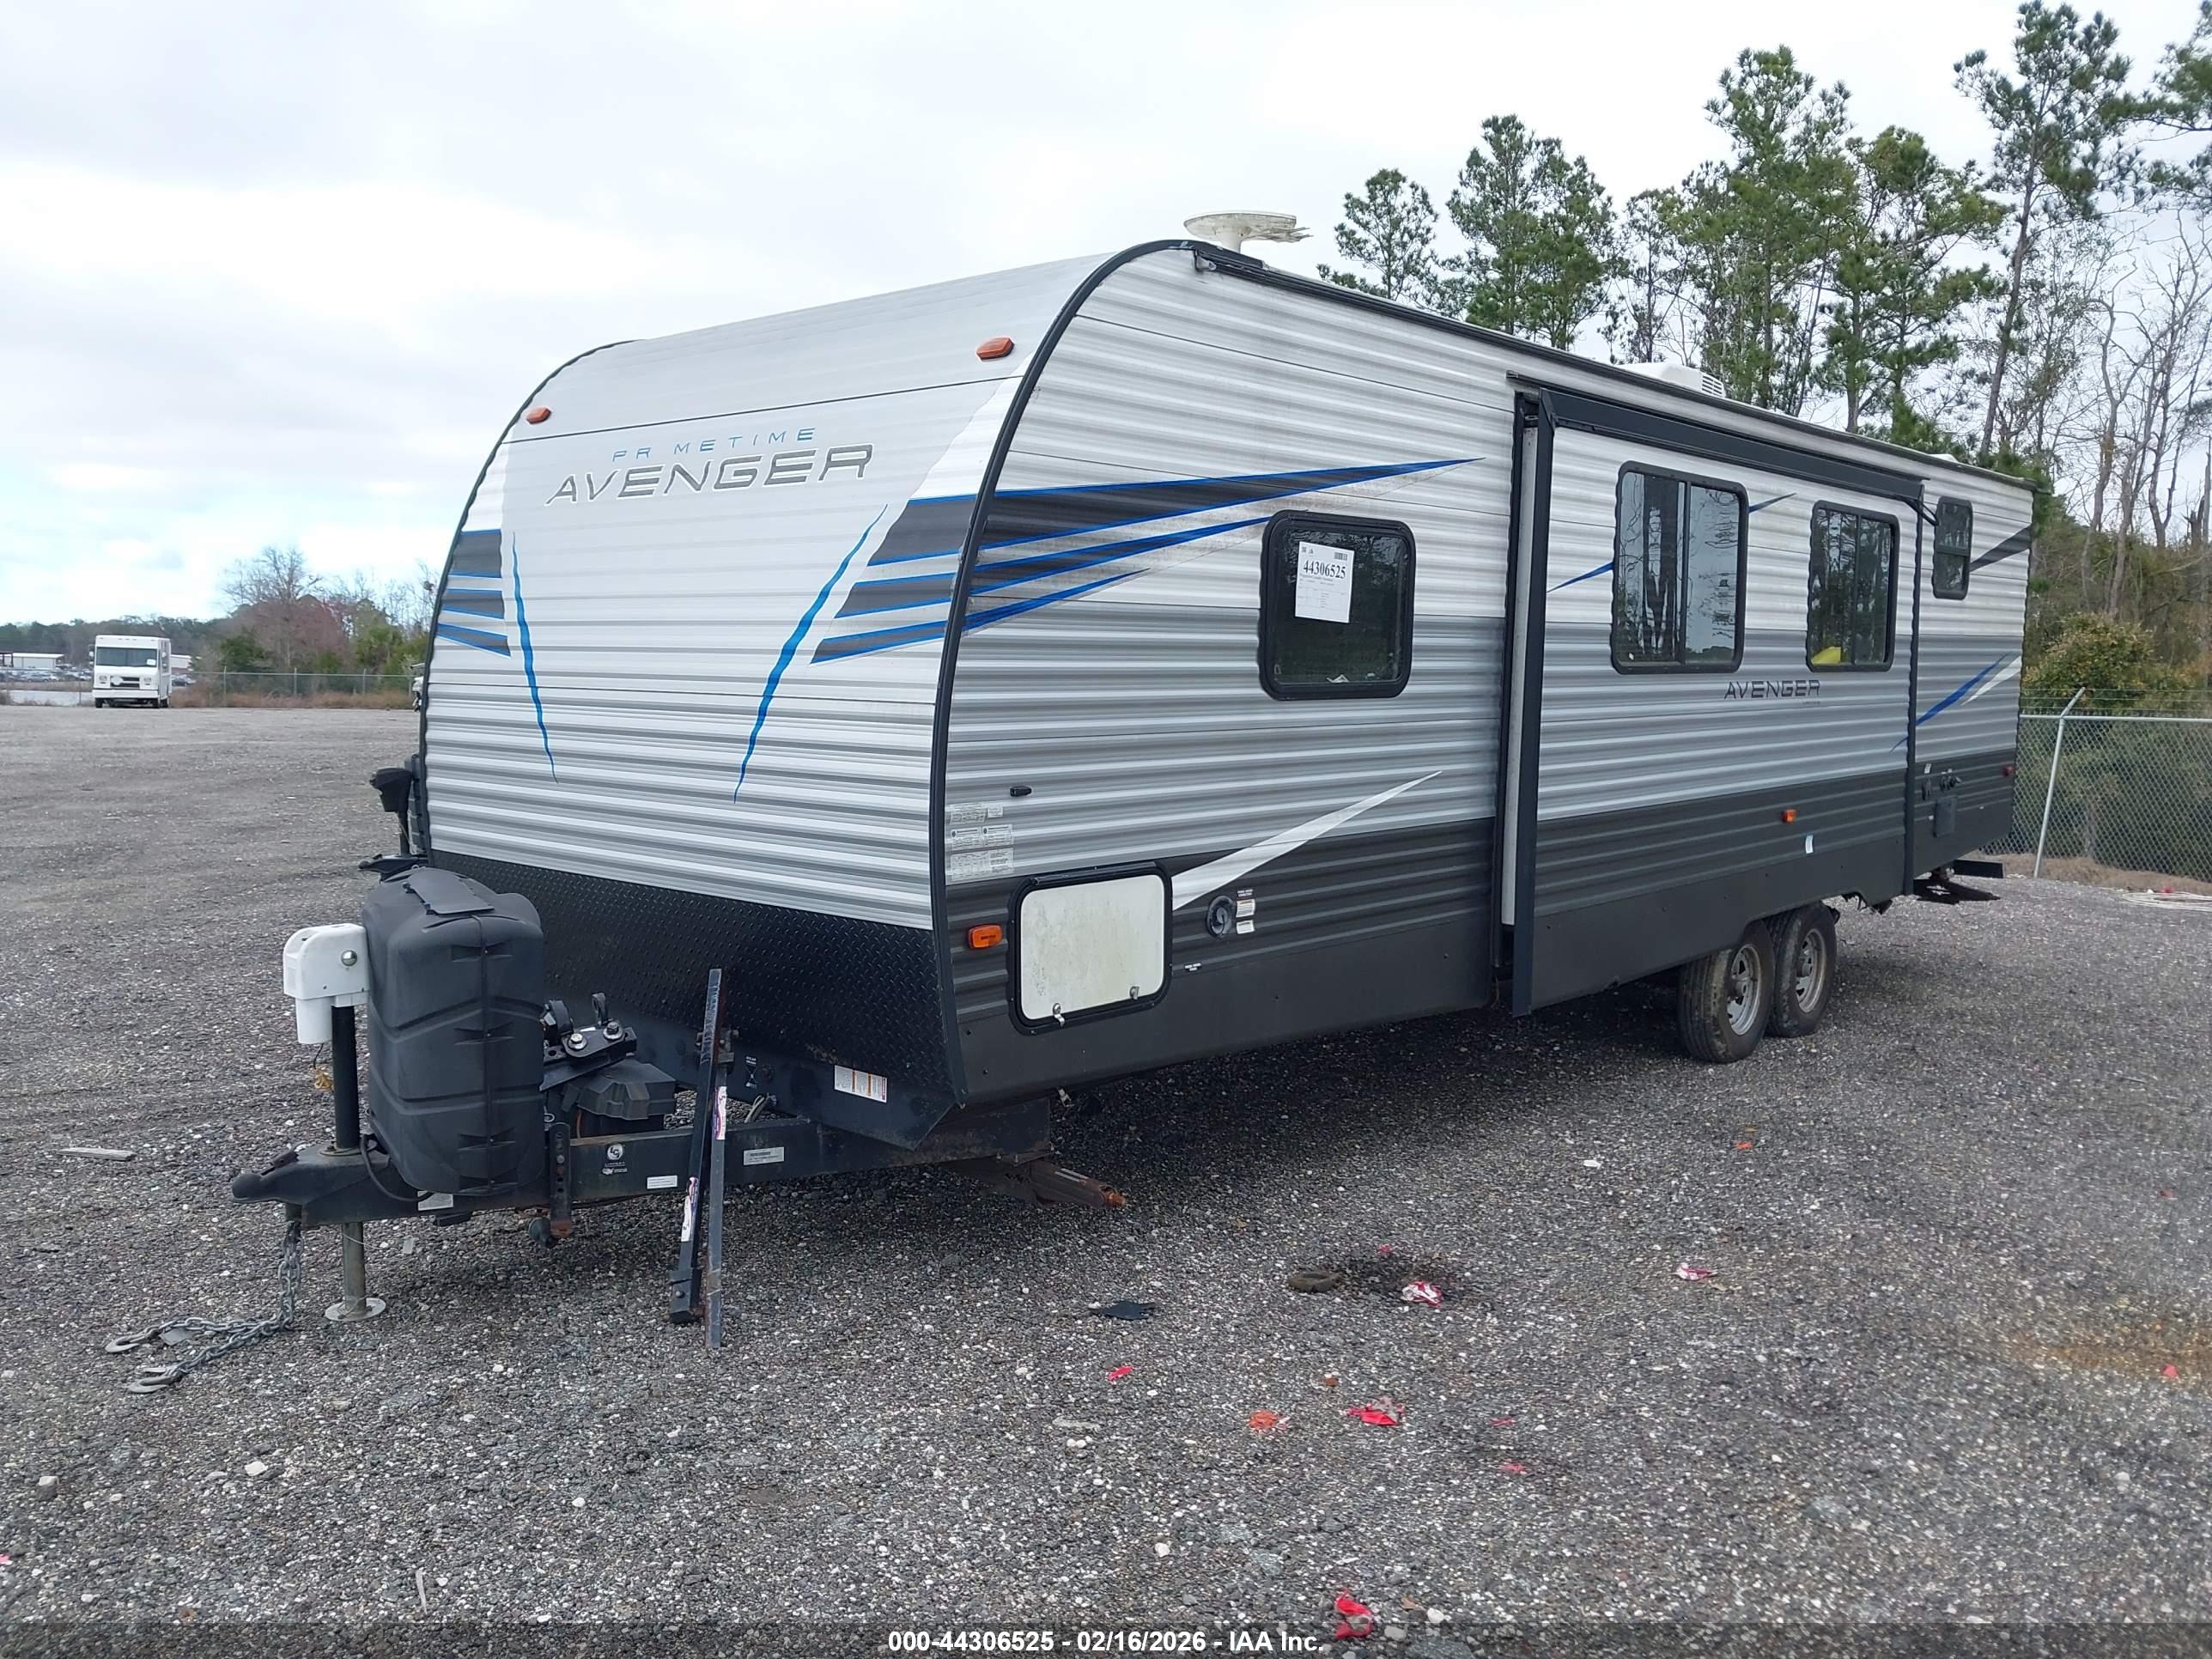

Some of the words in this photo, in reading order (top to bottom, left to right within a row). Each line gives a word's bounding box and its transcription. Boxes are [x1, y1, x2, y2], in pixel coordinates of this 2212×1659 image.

[612, 428, 816, 463] PRMETIME
[544, 443, 873, 506] AVENGER
[1303, 559, 1346, 580] 44306525
[1723, 679, 1821, 700] AVENGER
